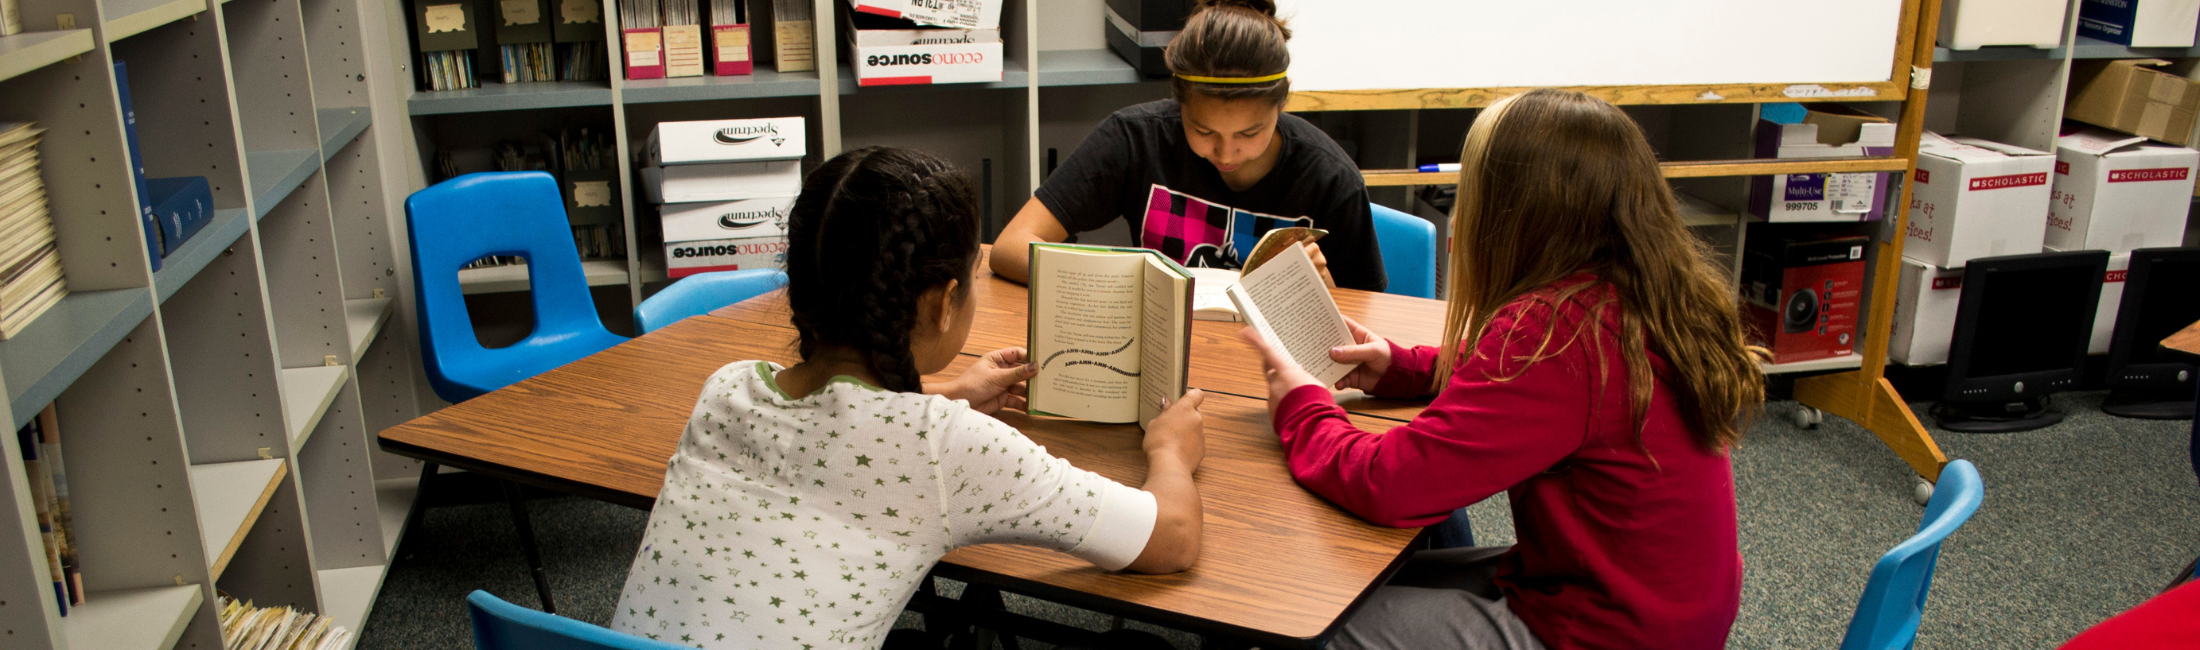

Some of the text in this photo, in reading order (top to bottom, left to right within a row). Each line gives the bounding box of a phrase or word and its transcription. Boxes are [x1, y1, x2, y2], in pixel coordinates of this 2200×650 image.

[867, 52, 983, 67] econosource
[722, 122, 779, 137] Spectrum
[1981, 175, 2045, 188] SCHOLASTIC
[2120, 170, 2186, 180] SCHOLASTIC
[1785, 202, 1818, 211] 999705
[2063, 193, 2075, 209] at
[727, 207, 783, 222] Spectrum
[1923, 203, 1935, 219] at
[673, 241, 788, 259] econosource
